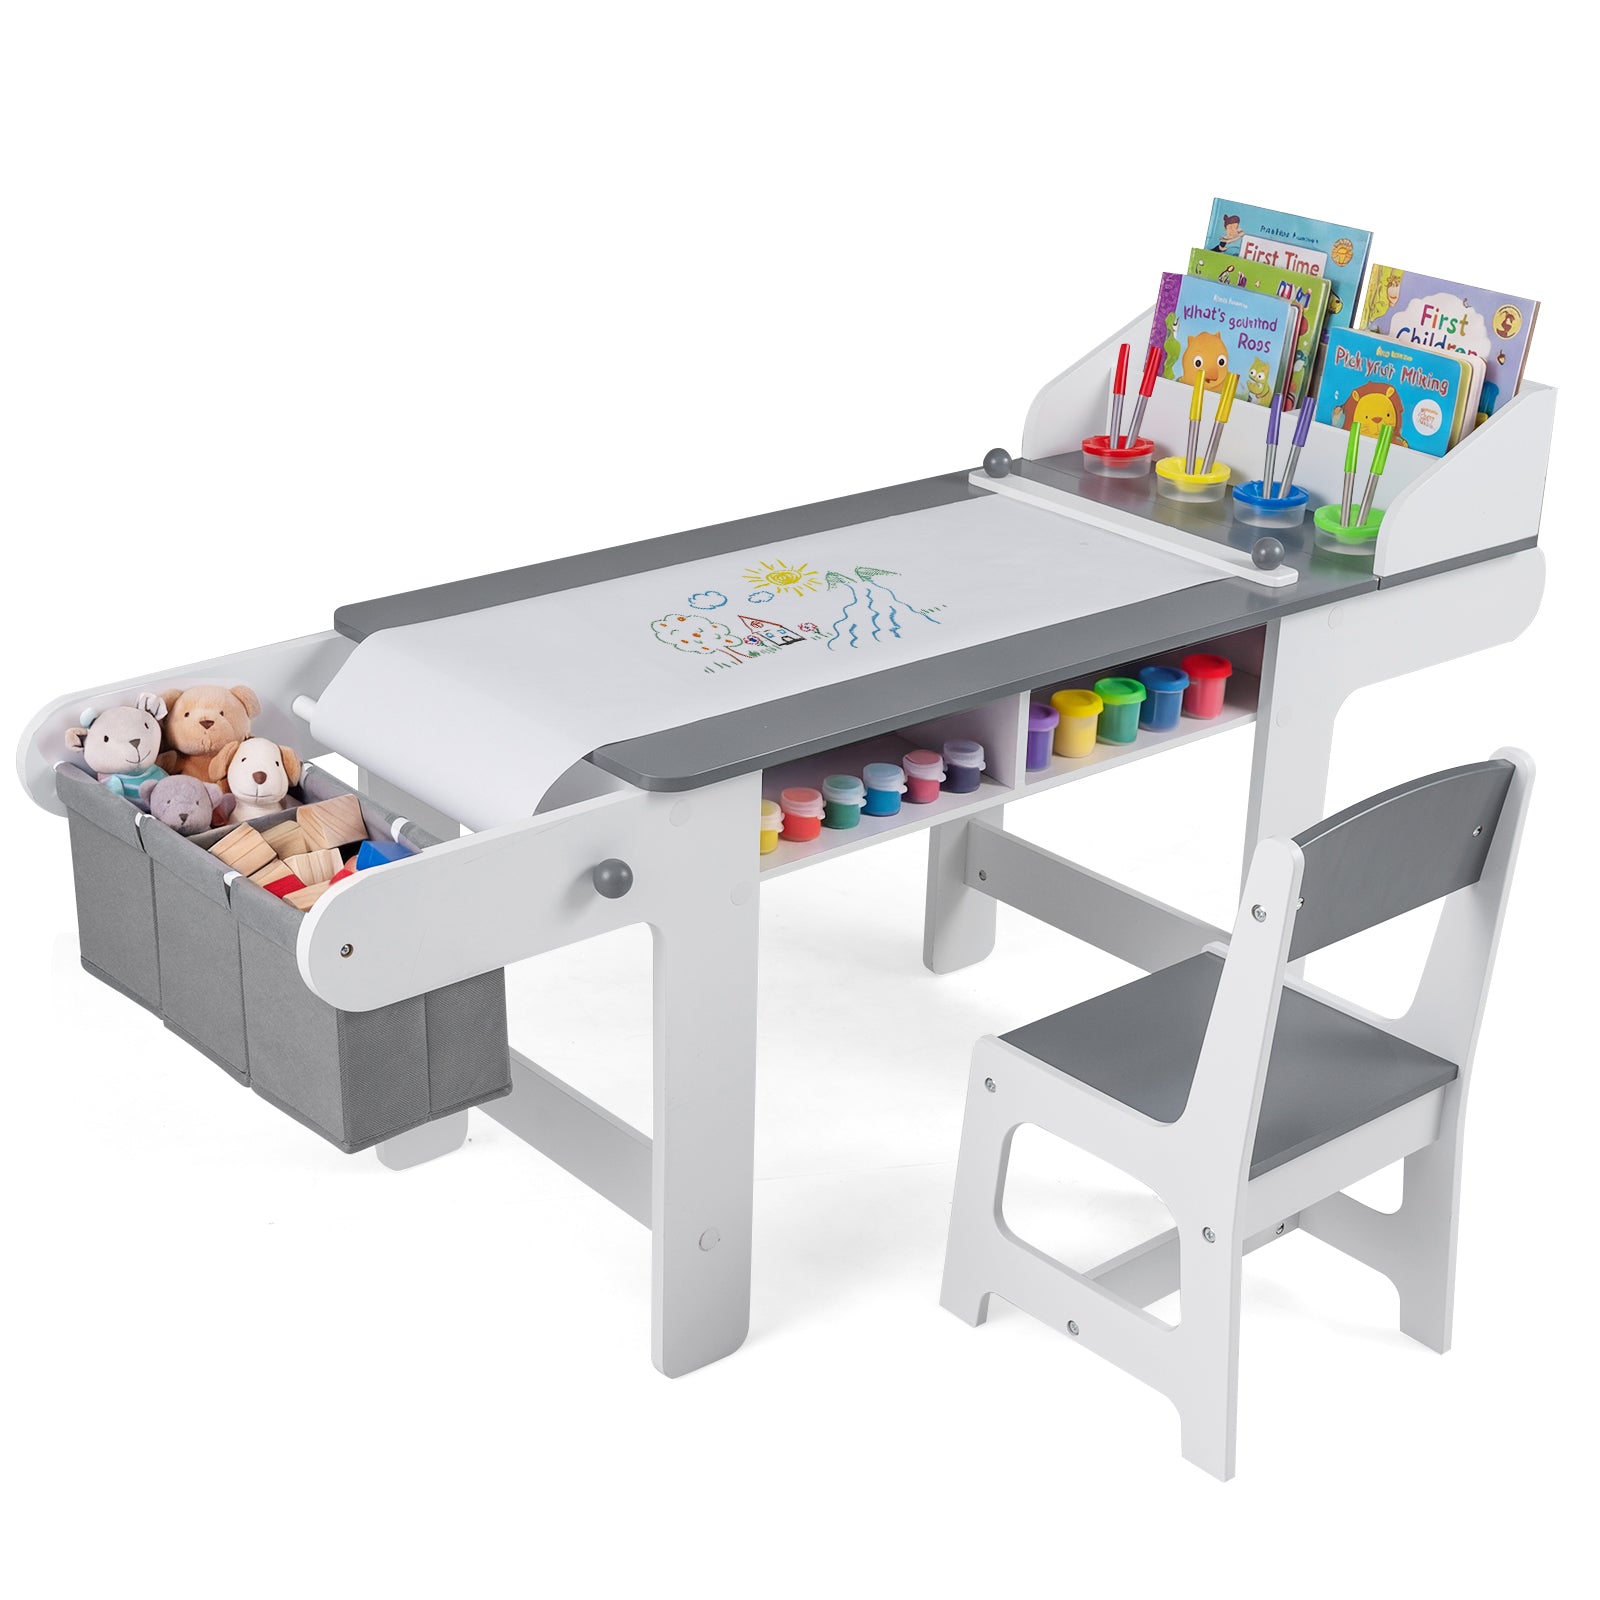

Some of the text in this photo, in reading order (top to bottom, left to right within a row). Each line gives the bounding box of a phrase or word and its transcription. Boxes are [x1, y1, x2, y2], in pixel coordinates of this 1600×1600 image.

[1243, 241, 1320, 277] First Time
[1420, 303, 1469, 337] First
